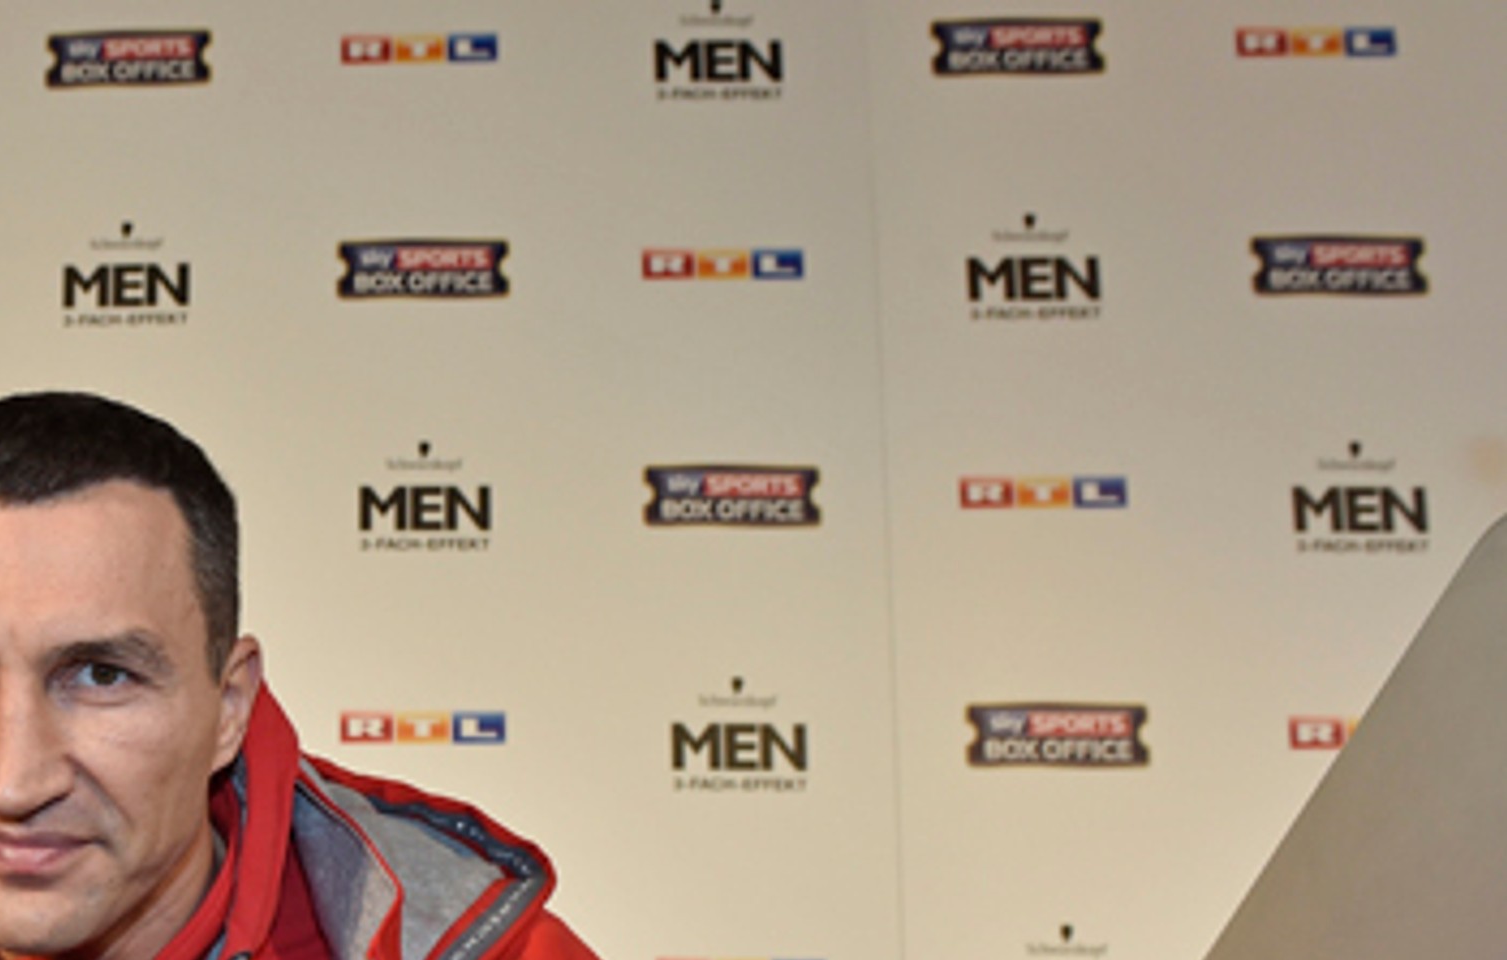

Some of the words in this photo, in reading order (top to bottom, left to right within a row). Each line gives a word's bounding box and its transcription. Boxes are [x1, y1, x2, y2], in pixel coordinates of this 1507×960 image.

[343, 36, 495, 62] RTL
[1238, 30, 1394, 55] RTL
[654, 39, 783, 82] MEN
[645, 251, 801, 277] RTL
[62, 262, 190, 308] MEN
[966, 255, 1101, 302] MEN
[705, 472, 802, 497] SPORTS
[962, 479, 1125, 506] RTL
[359, 485, 492, 531] MEN
[715, 499, 805, 521] OFFICE
[1292, 486, 1429, 533] MEN
[343, 714, 503, 741] RTL
[1029, 711, 1129, 737] SPORTS
[671, 722, 808, 771] MEN
[1041, 738, 1134, 761] OFFICE
